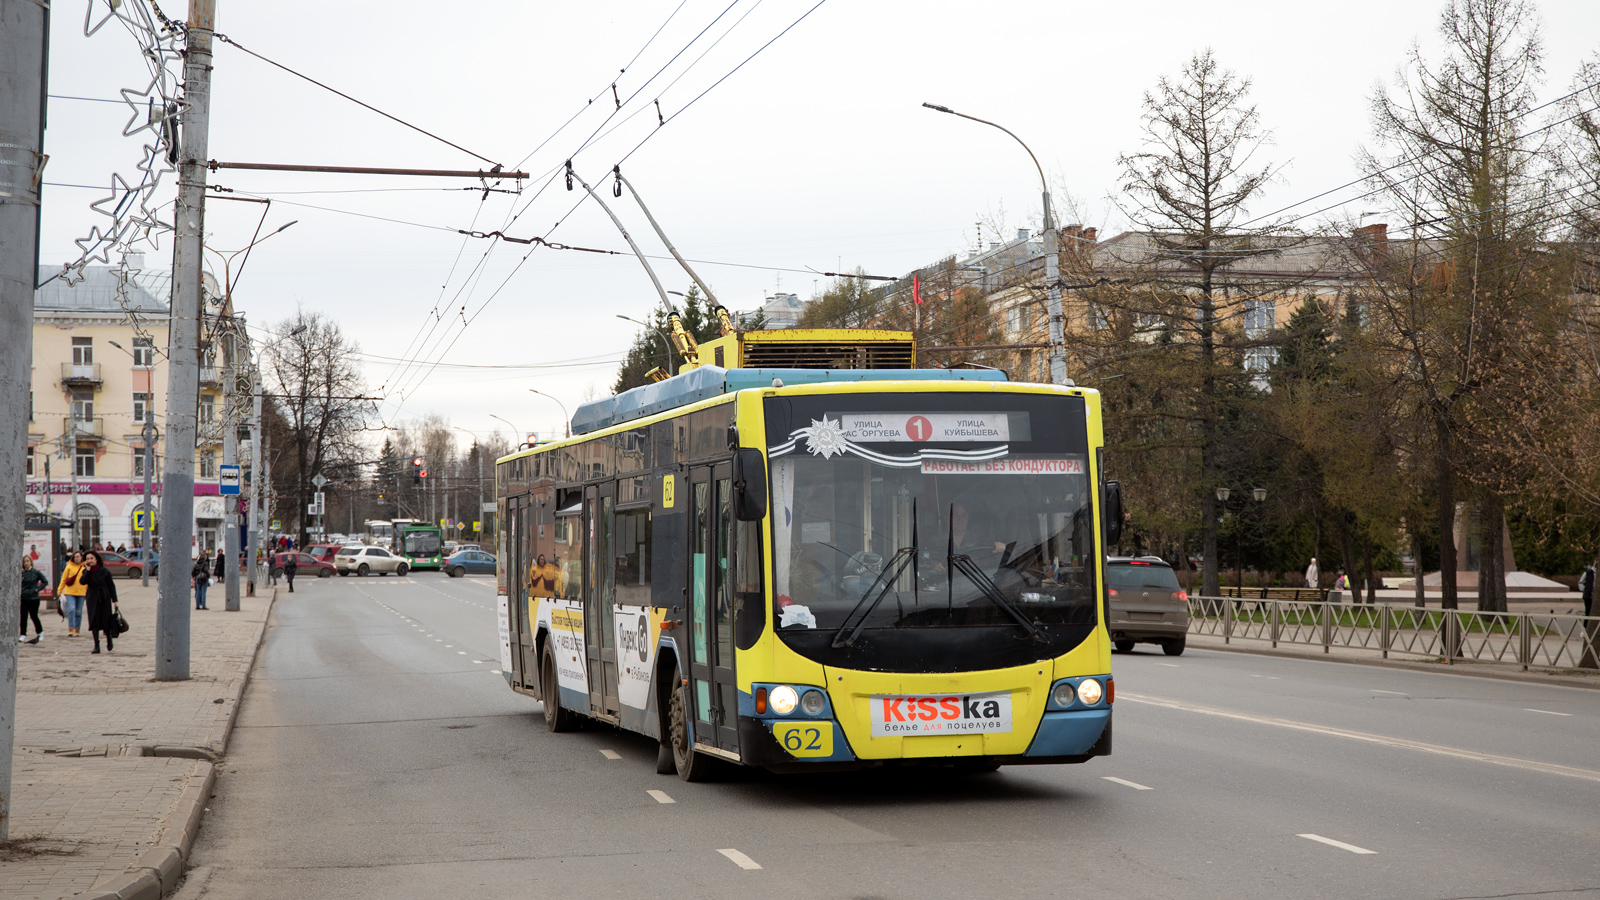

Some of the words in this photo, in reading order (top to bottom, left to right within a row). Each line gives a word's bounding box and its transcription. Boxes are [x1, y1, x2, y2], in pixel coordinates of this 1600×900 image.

[854, 420, 883, 429] УЛИЦА
[912, 418, 924, 440] 1
[956, 420, 986, 428] УЛИЦА
[843, 429, 901, 438] АСОРГУЕВА
[944, 427, 999, 436] КУЙБЫШЕВА
[924, 460, 981, 472] РАБОТАЕТ
[985, 460, 1006, 472] БЕЗ
[1008, 459, 1081, 474] КОНДУКТОРА
[665, 481, 672, 501] 62
[884, 723, 918, 732] белье
[923, 723, 942, 732] для
[947, 720, 1001, 730] поцелуев
[784, 728, 822, 751] 62
